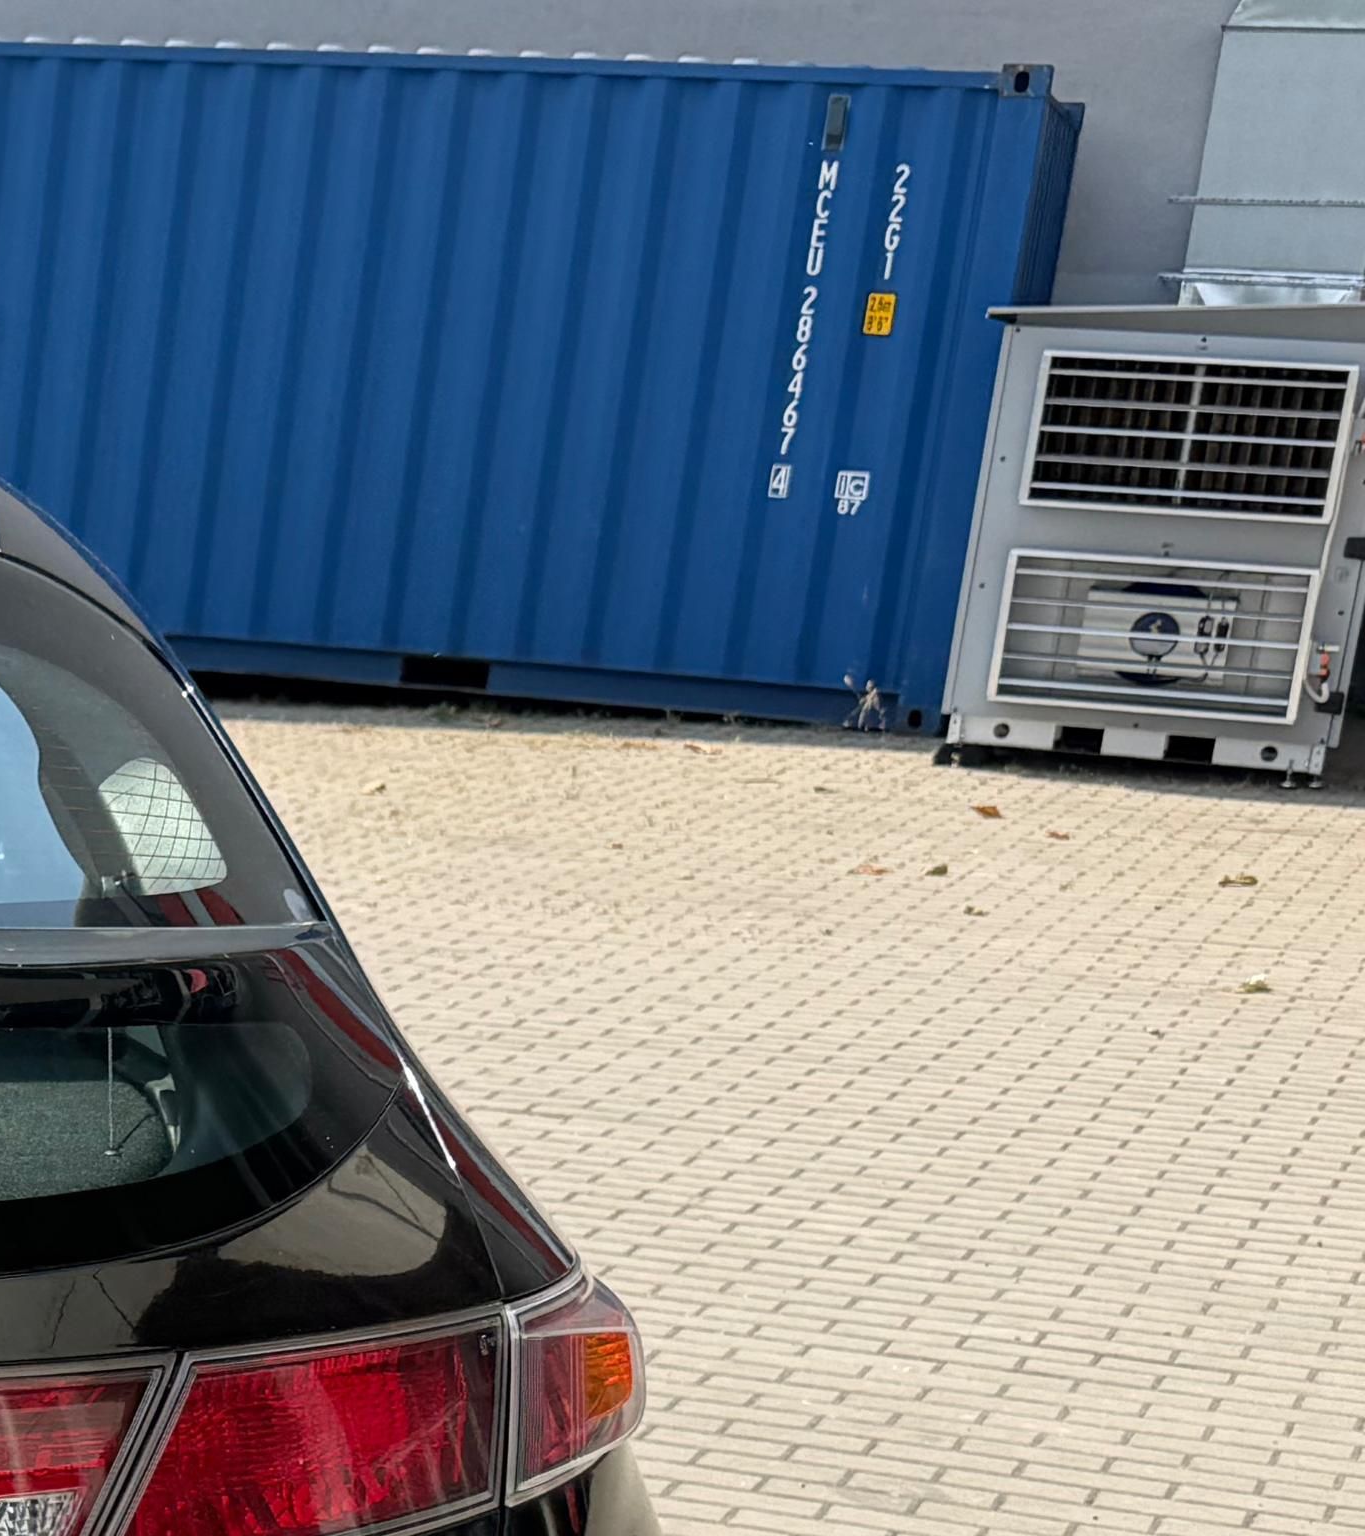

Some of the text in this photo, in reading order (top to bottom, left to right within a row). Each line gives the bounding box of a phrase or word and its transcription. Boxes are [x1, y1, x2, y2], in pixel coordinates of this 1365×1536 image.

[806, 160, 839, 276] MCEU
[883, 163, 911, 280] 22G1
[780, 285, 818, 455] 286467
[837, 500, 861, 516] 87
